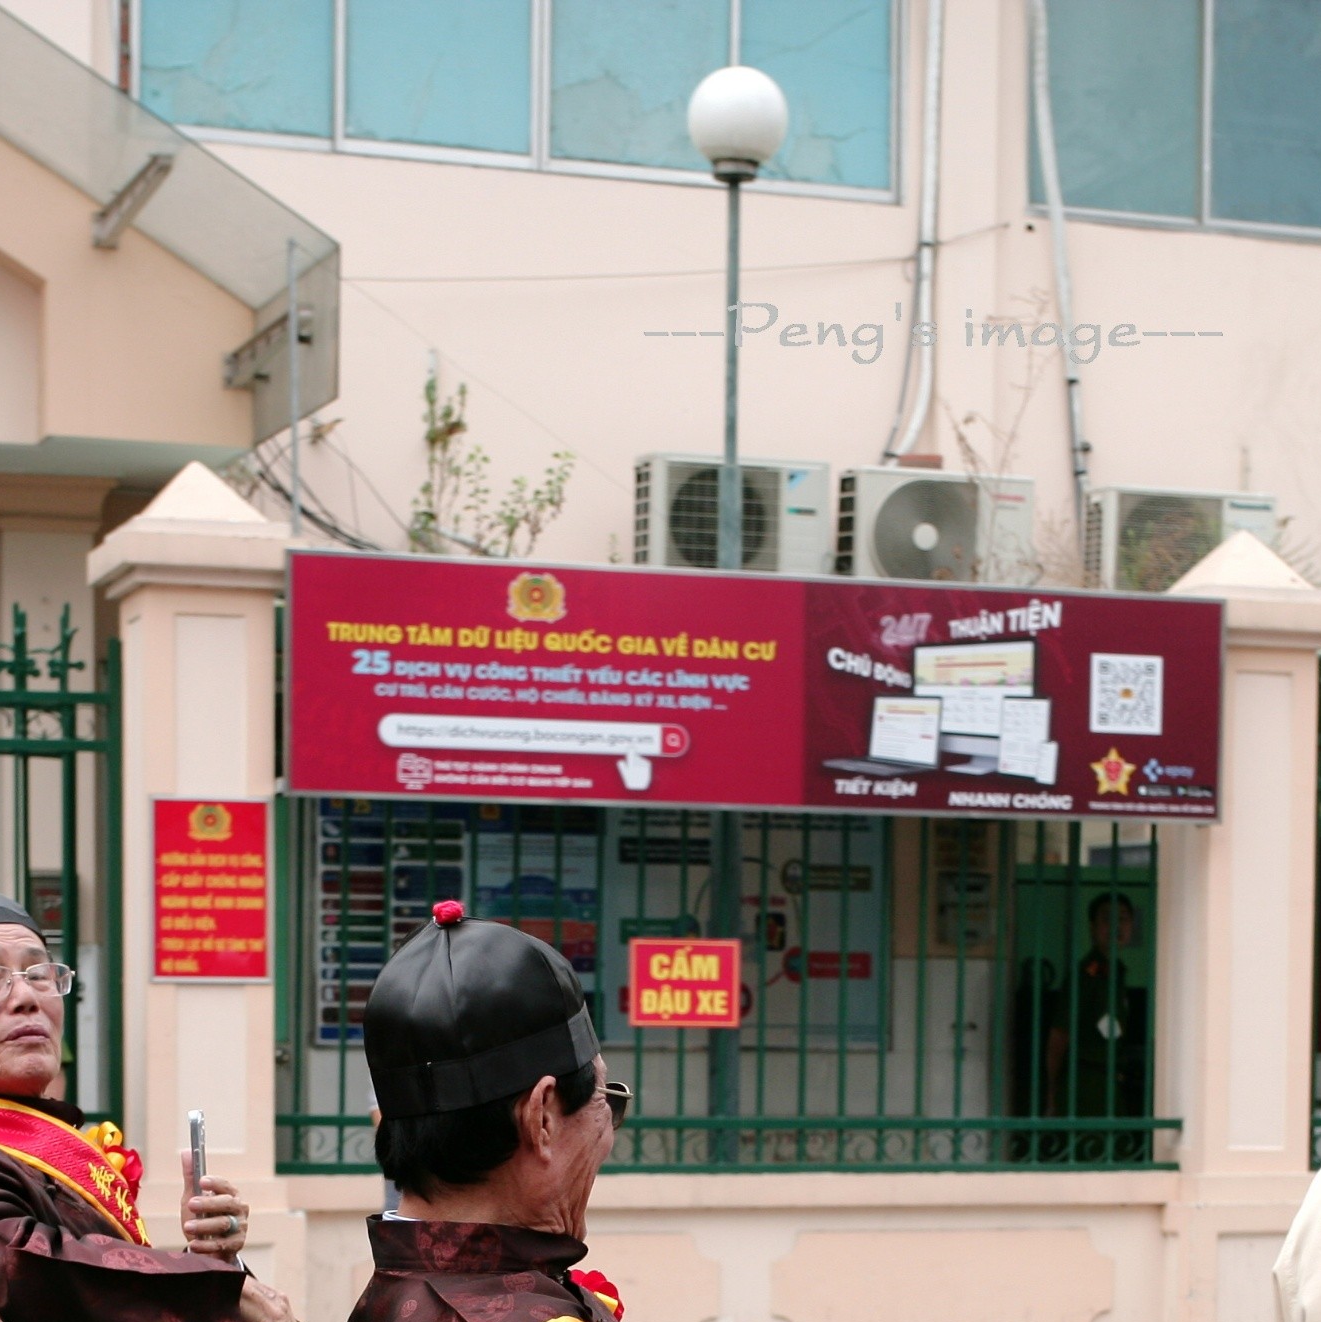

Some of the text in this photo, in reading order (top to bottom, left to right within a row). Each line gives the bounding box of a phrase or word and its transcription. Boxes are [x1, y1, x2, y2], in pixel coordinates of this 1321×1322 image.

[1006, 598, 1063, 636] TIỆN
[327, 622, 403, 644] TRUNG
[406, 623, 453, 646] TÂM
[458, 625, 491, 648] DỮ
[495, 627, 539, 653] LIỆU
[543, 629, 613, 654] QUỐC
[617, 635, 659, 656] GIA
[692, 637, 739, 660] DÂN
[742, 640, 777, 662] CƯ
[351, 648, 392, 676] 25
[393, 660, 442, 680] DỊCH
[474, 661, 529, 682] CÔNG
[827, 646, 872, 678] CHỦ
[948, 791, 1010, 808] NHANH
[1012, 790, 1074, 810] CHÓNG
[649, 945, 720, 981] CẤM
[640, 983, 728, 1020] ĐẬU XE
